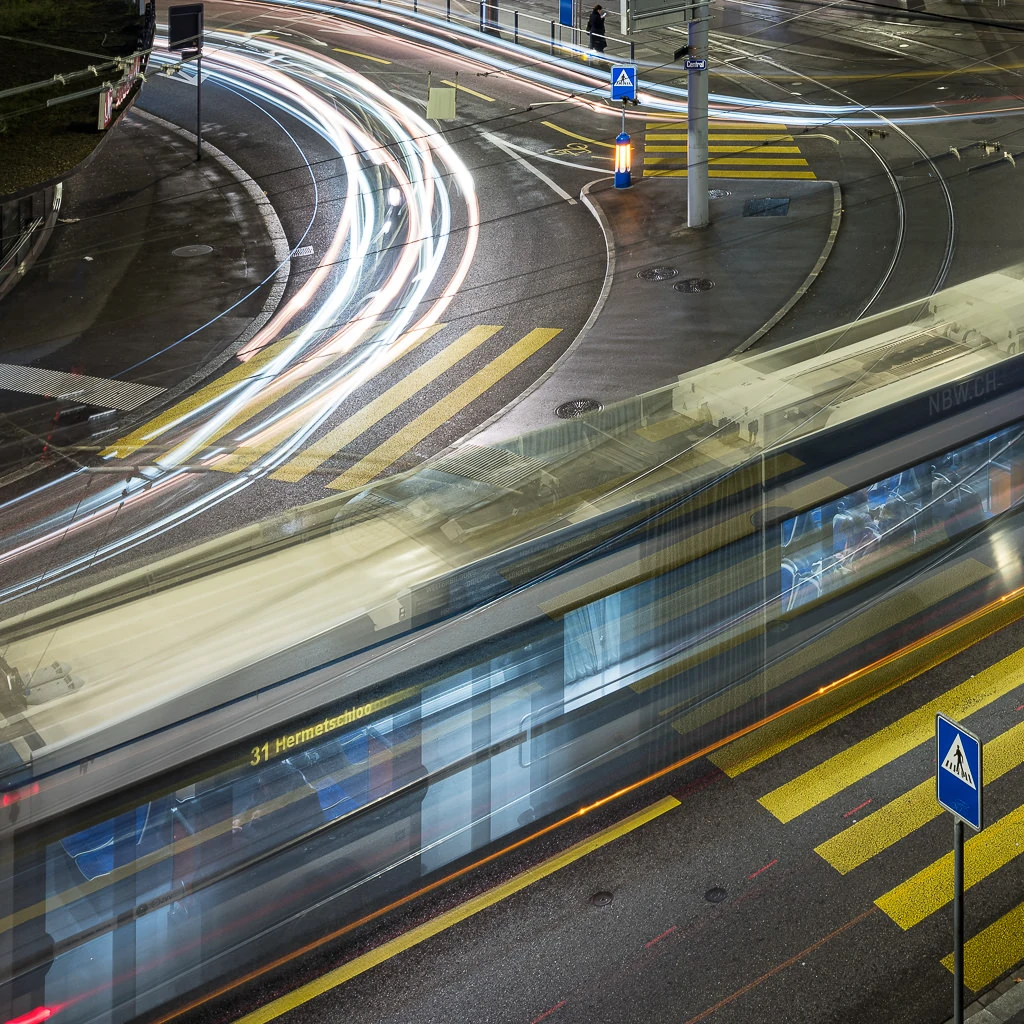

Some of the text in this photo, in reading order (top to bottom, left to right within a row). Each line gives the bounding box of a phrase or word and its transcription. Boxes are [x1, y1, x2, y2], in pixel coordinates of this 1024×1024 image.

[687, 60, 705, 68] Central
[929, 369, 997, 417] NBW.CH
[250, 741, 270, 766] 31
